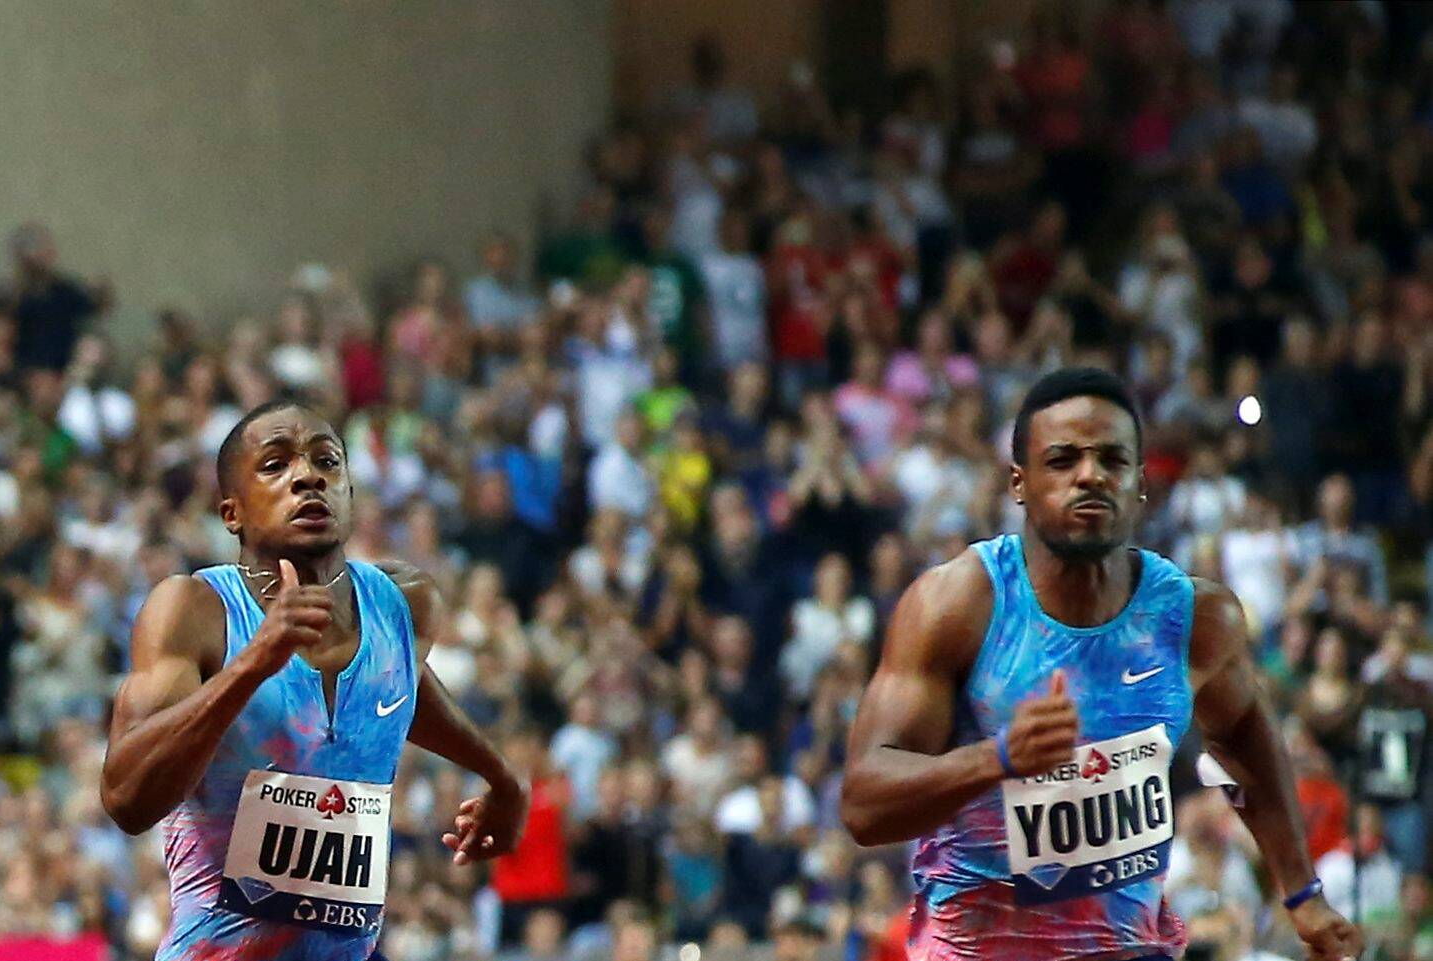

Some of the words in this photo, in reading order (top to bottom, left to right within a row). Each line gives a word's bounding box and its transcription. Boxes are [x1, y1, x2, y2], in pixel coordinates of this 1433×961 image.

[1021, 763, 1080, 785] KER
[1109, 742, 1157, 770] STARS
[259, 783, 316, 809] POKER
[346, 796, 381, 815] STARS
[1014, 775, 1167, 857] YOUNG
[258, 822, 373, 888] UJAH
[1115, 849, 1160, 880] EBS
[321, 903, 367, 928] EBS
